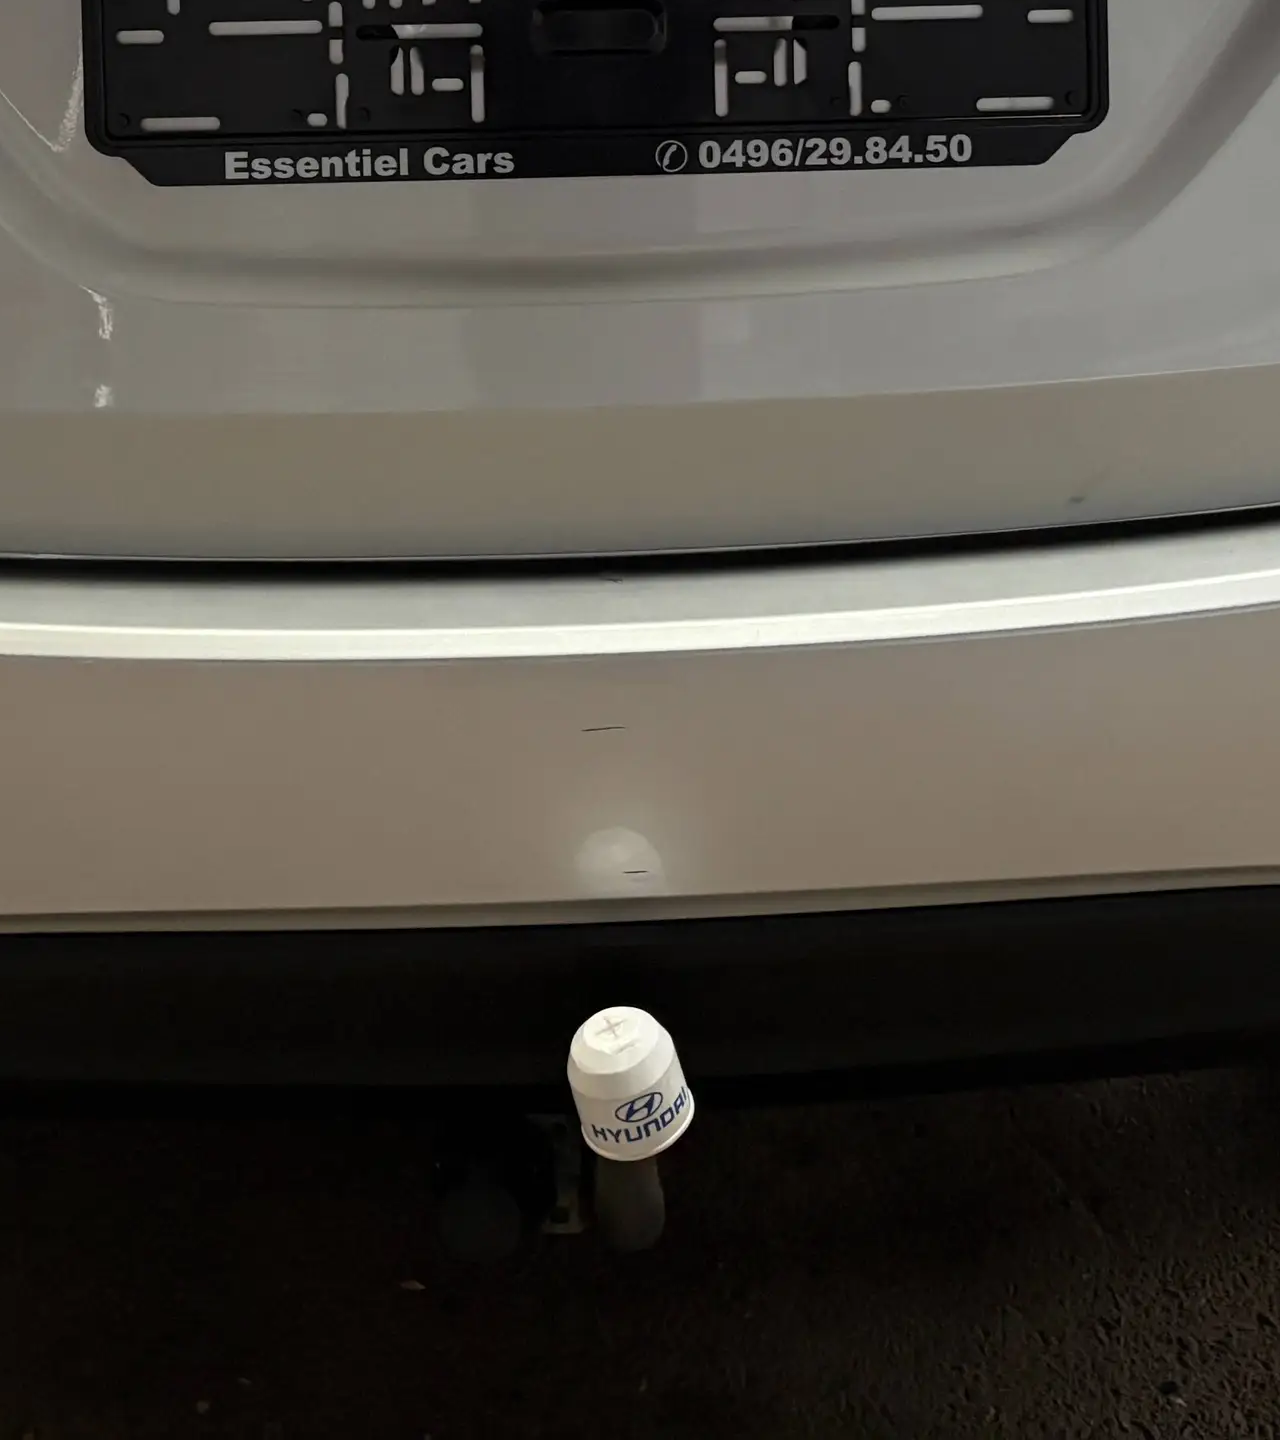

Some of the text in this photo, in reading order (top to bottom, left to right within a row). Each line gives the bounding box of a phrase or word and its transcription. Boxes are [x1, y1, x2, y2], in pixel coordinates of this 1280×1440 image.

[224, 147, 516, 180] Essentiel Cars
[698, 134, 973, 168] 0496/29.84.50
[592, 1086, 688, 1143] HYUNDAI
